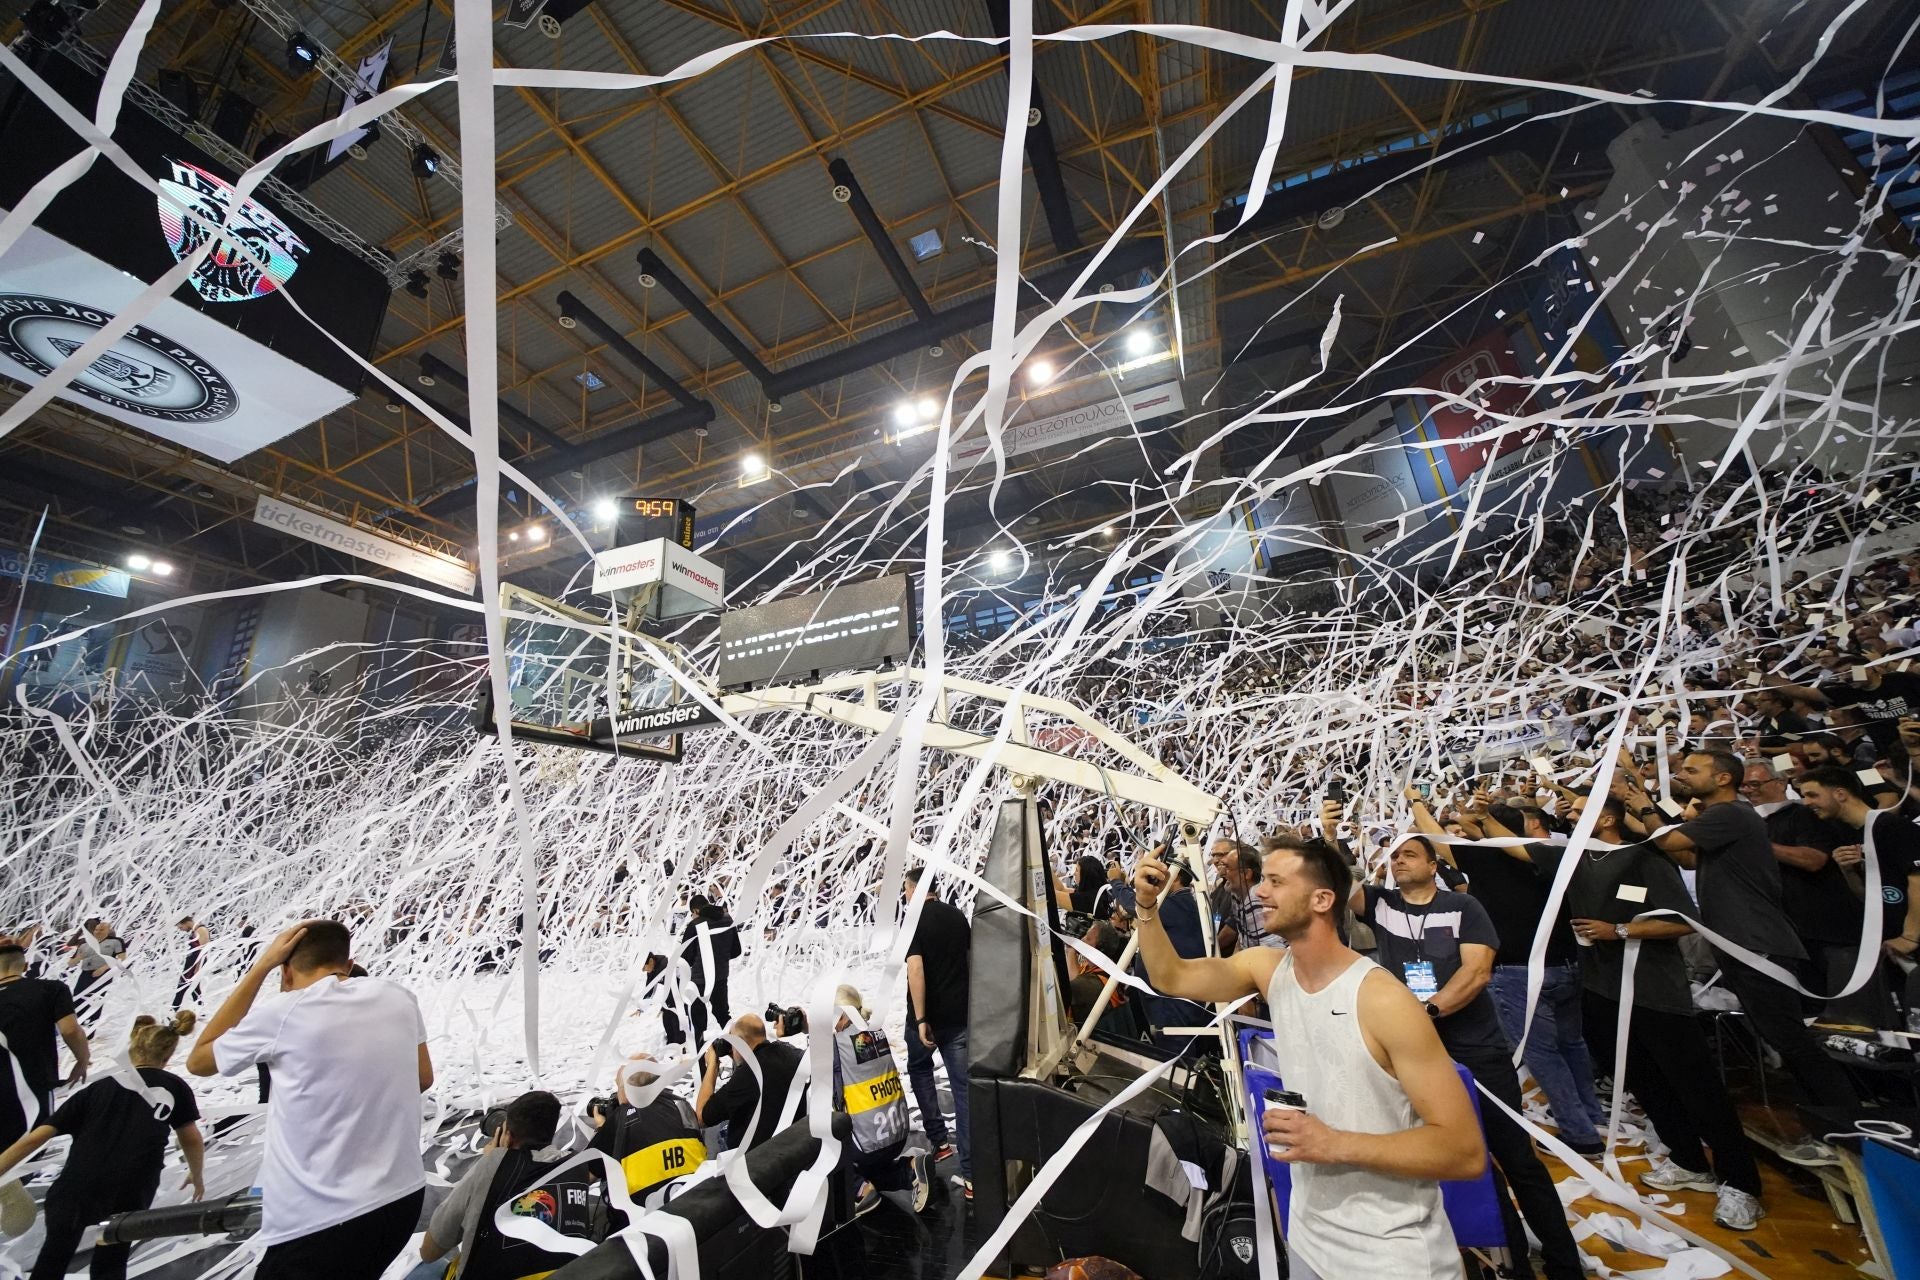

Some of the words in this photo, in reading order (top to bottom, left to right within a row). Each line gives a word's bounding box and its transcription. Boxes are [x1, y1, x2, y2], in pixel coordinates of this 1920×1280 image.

[168, 348, 221, 384] PAOK
[636, 500, 673, 517] 9:59
[259, 504, 397, 562] ticketmaster
[671, 560, 719, 591] winmasters
[616, 703, 700, 734] winmasters
[661, 1146, 686, 1171] HB
